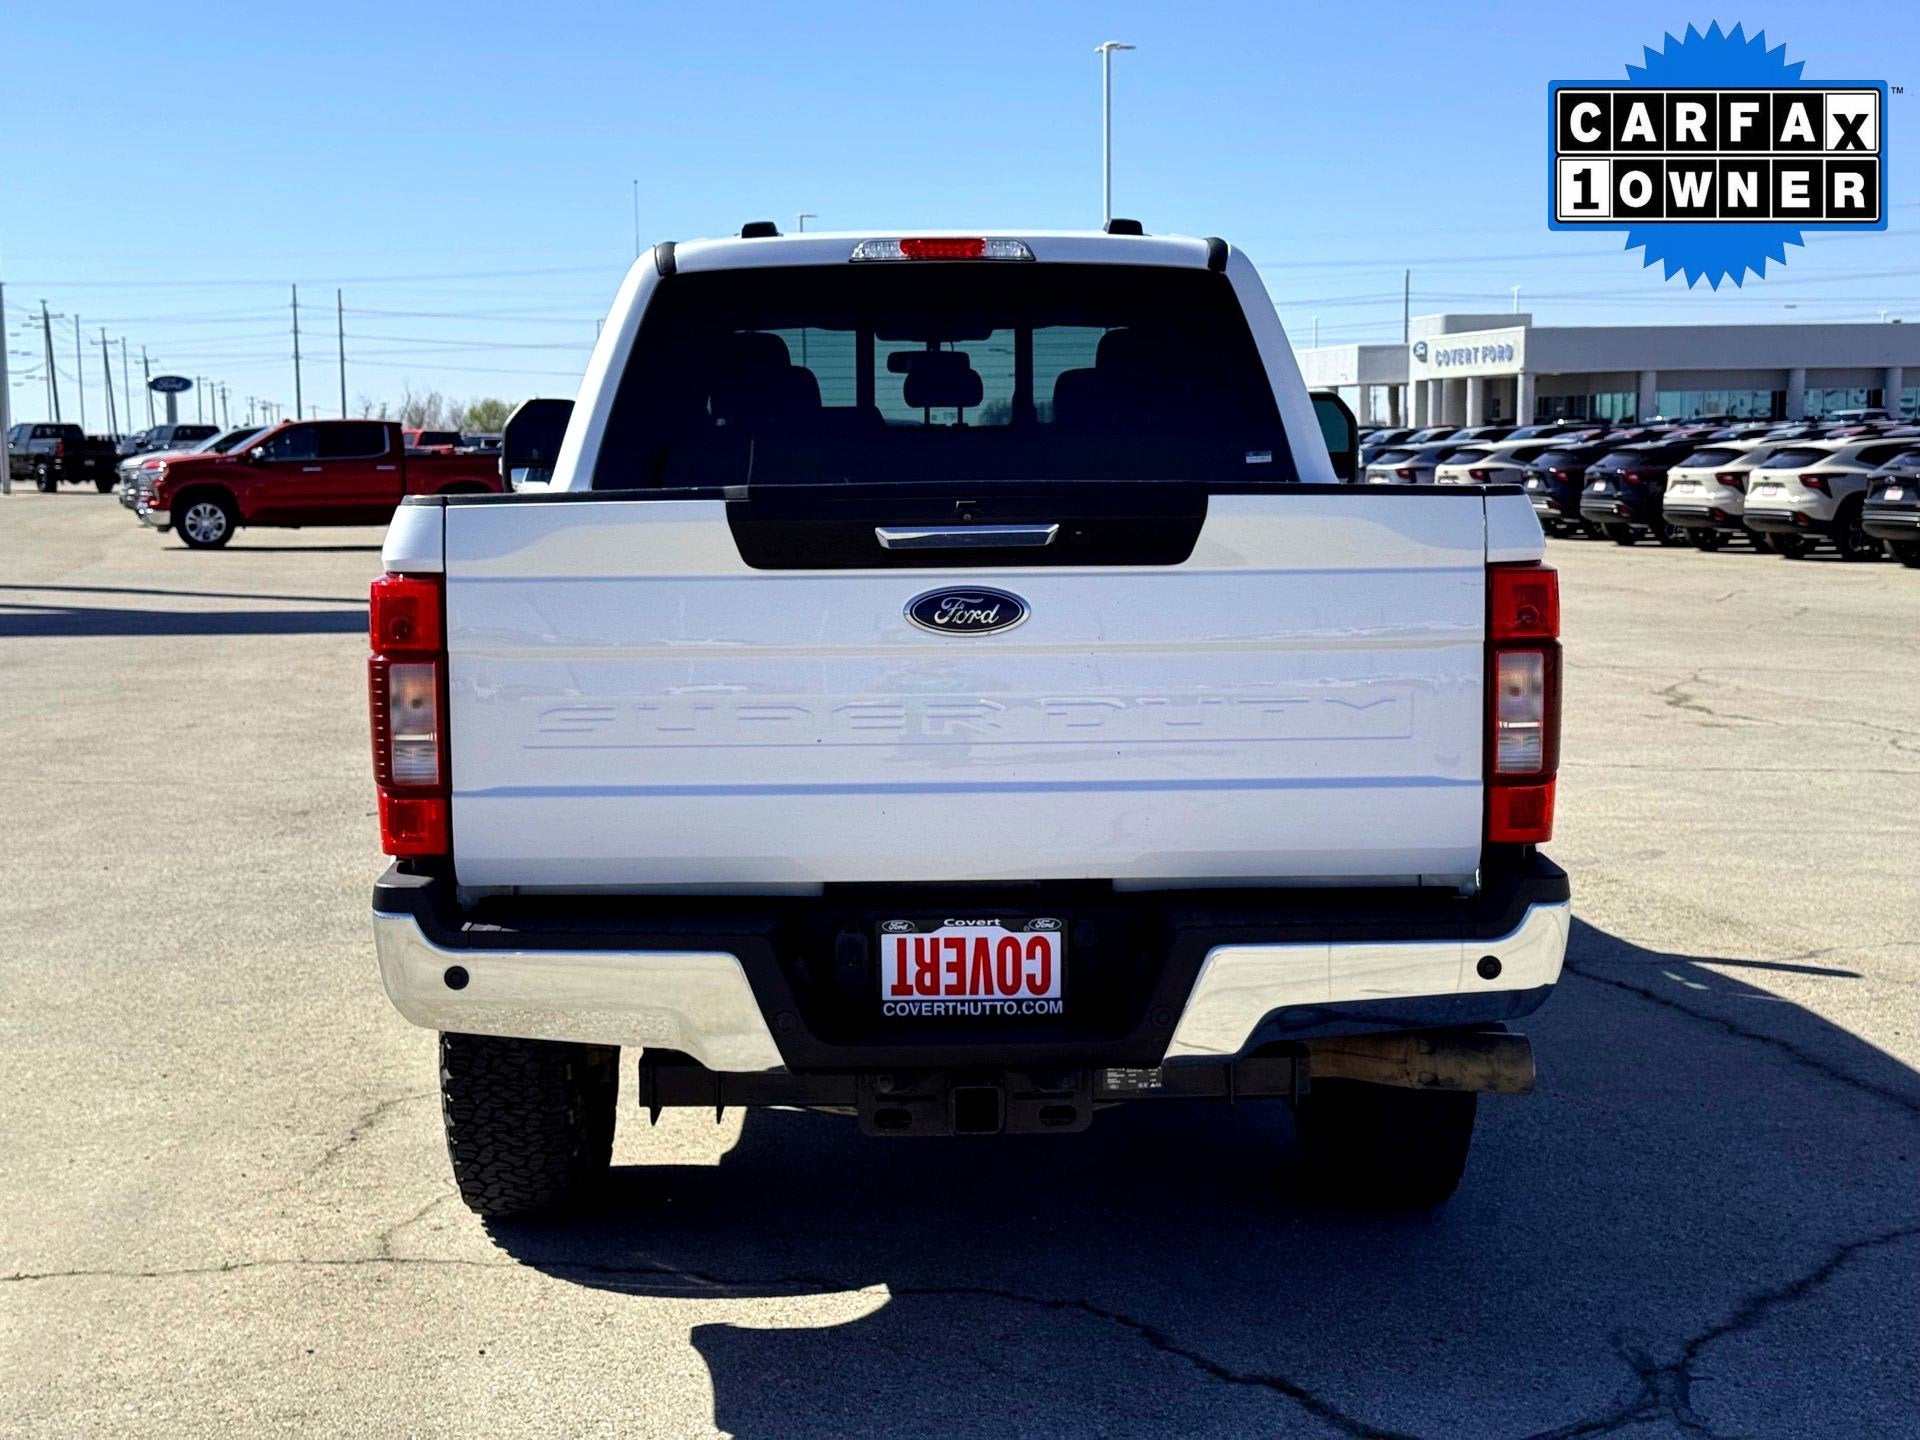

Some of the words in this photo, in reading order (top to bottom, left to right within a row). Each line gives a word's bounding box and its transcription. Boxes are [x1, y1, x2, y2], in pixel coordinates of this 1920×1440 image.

[1434, 349, 1479, 367] COVERT
[1481, 344, 1514, 363] FORD
[933, 596, 1001, 624] Ford
[943, 918, 1001, 928] Covert
[890, 935, 1052, 997] COVERT
[882, 1000, 1064, 1017] COVERTHUTTO.COM
